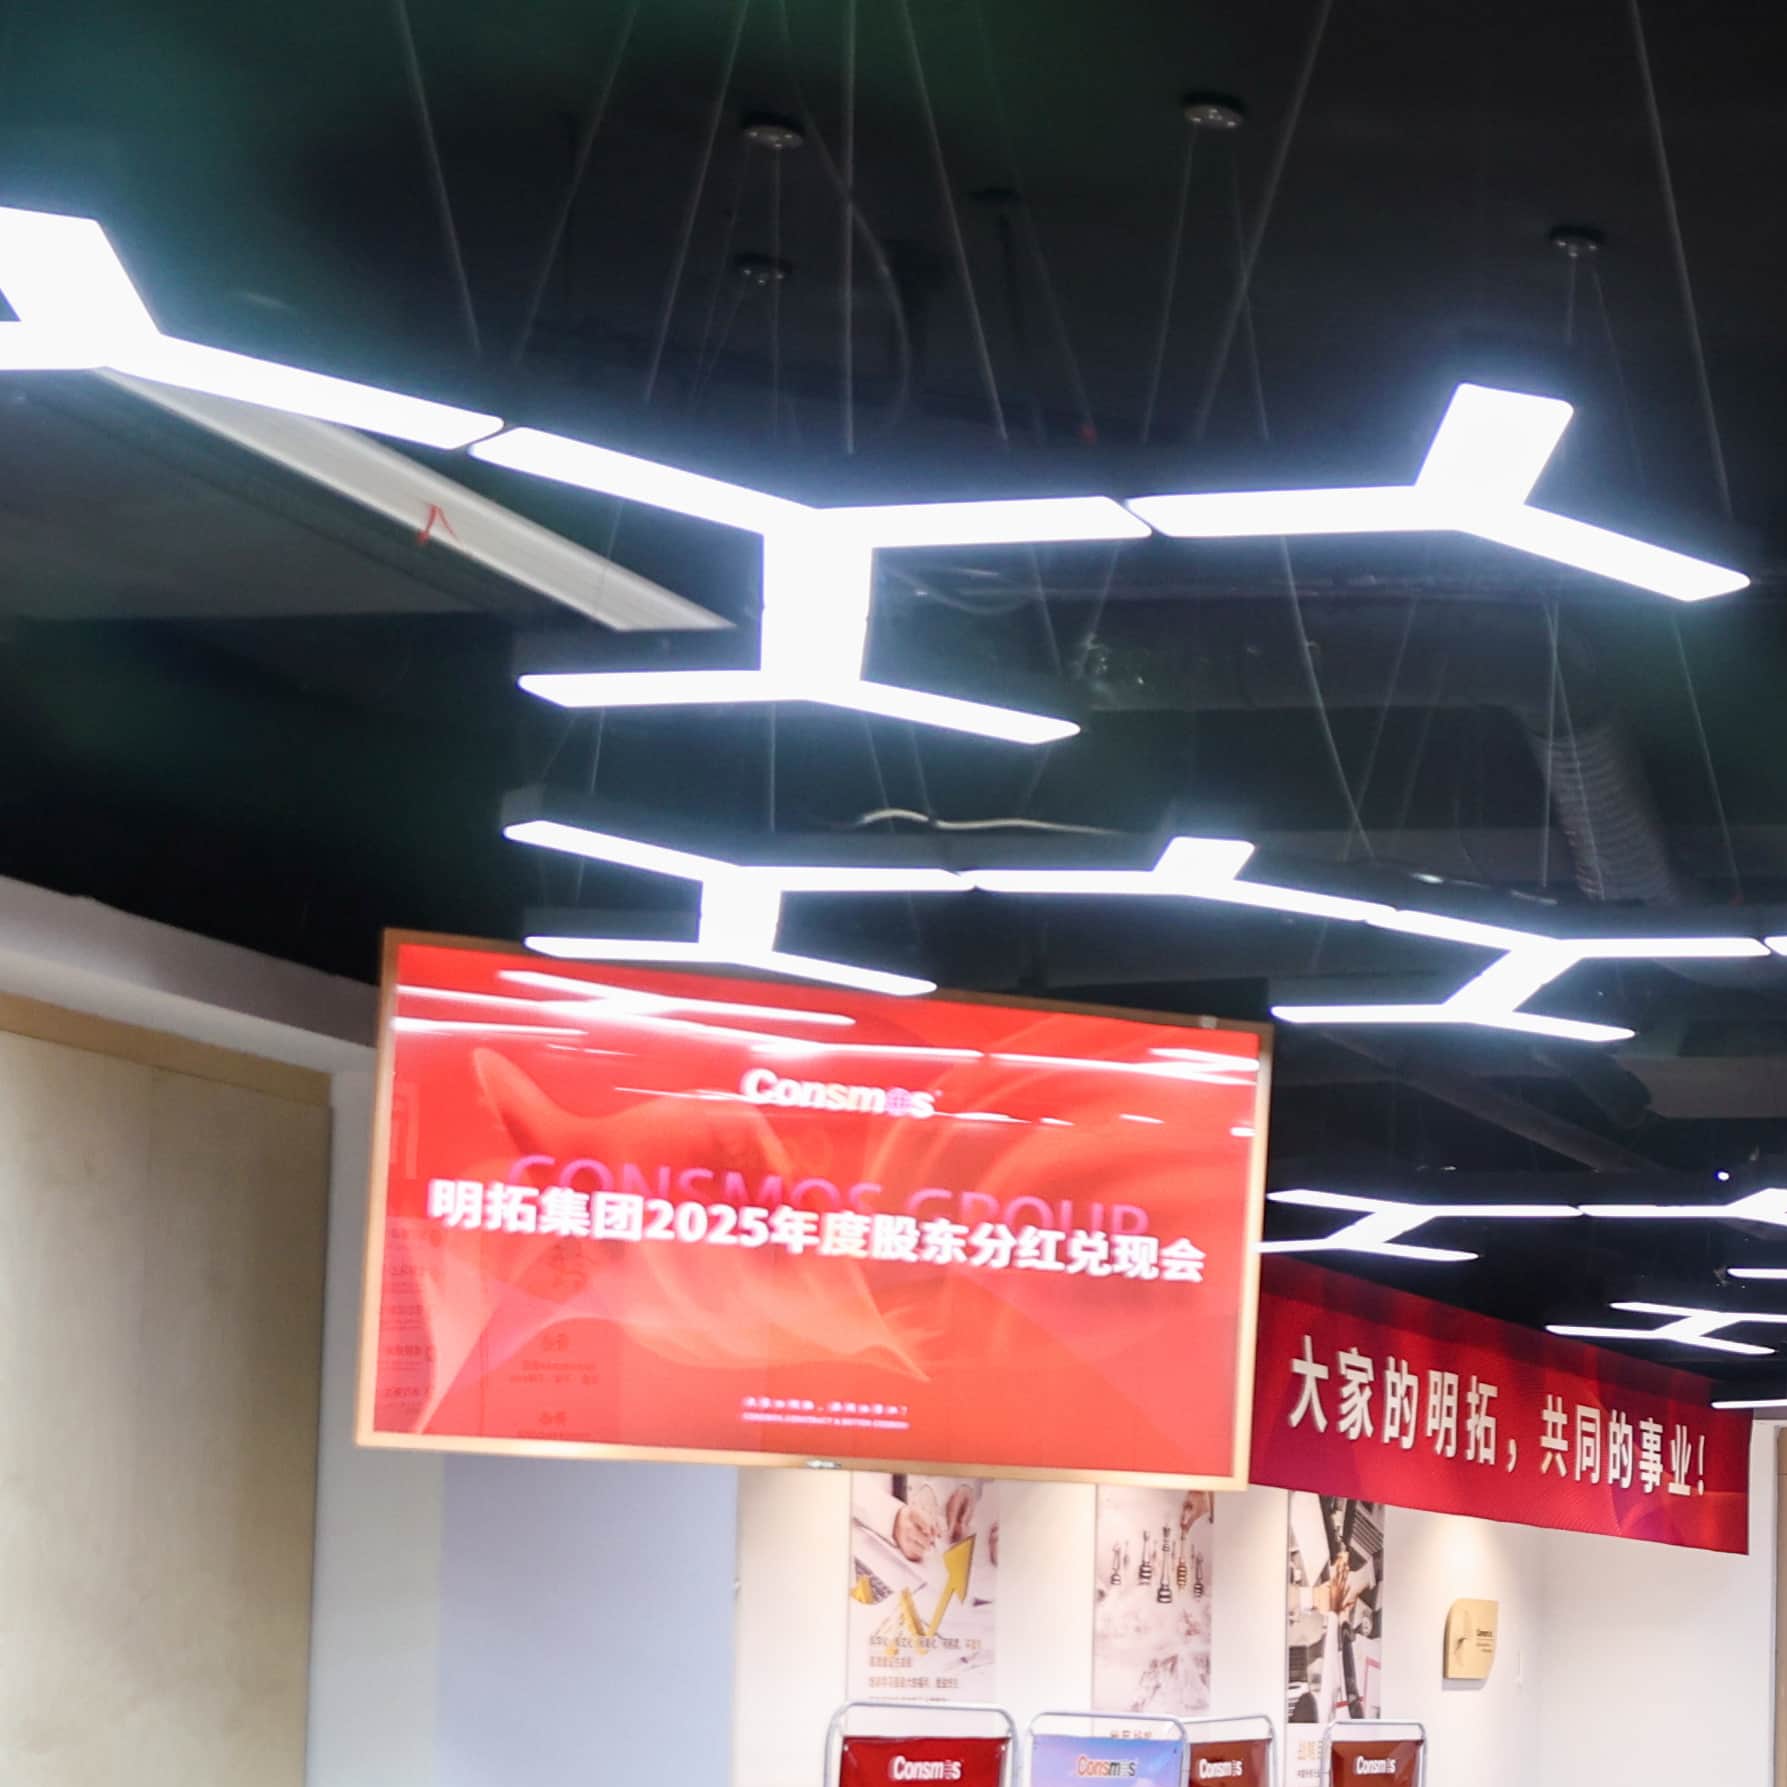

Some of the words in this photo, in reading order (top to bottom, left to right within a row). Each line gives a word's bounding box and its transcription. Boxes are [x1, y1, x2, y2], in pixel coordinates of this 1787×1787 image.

[427, 1177, 1207, 1284] 明拓集团2025年度股东分红兑现会
[893, 1755, 962, 1780] Consmos
